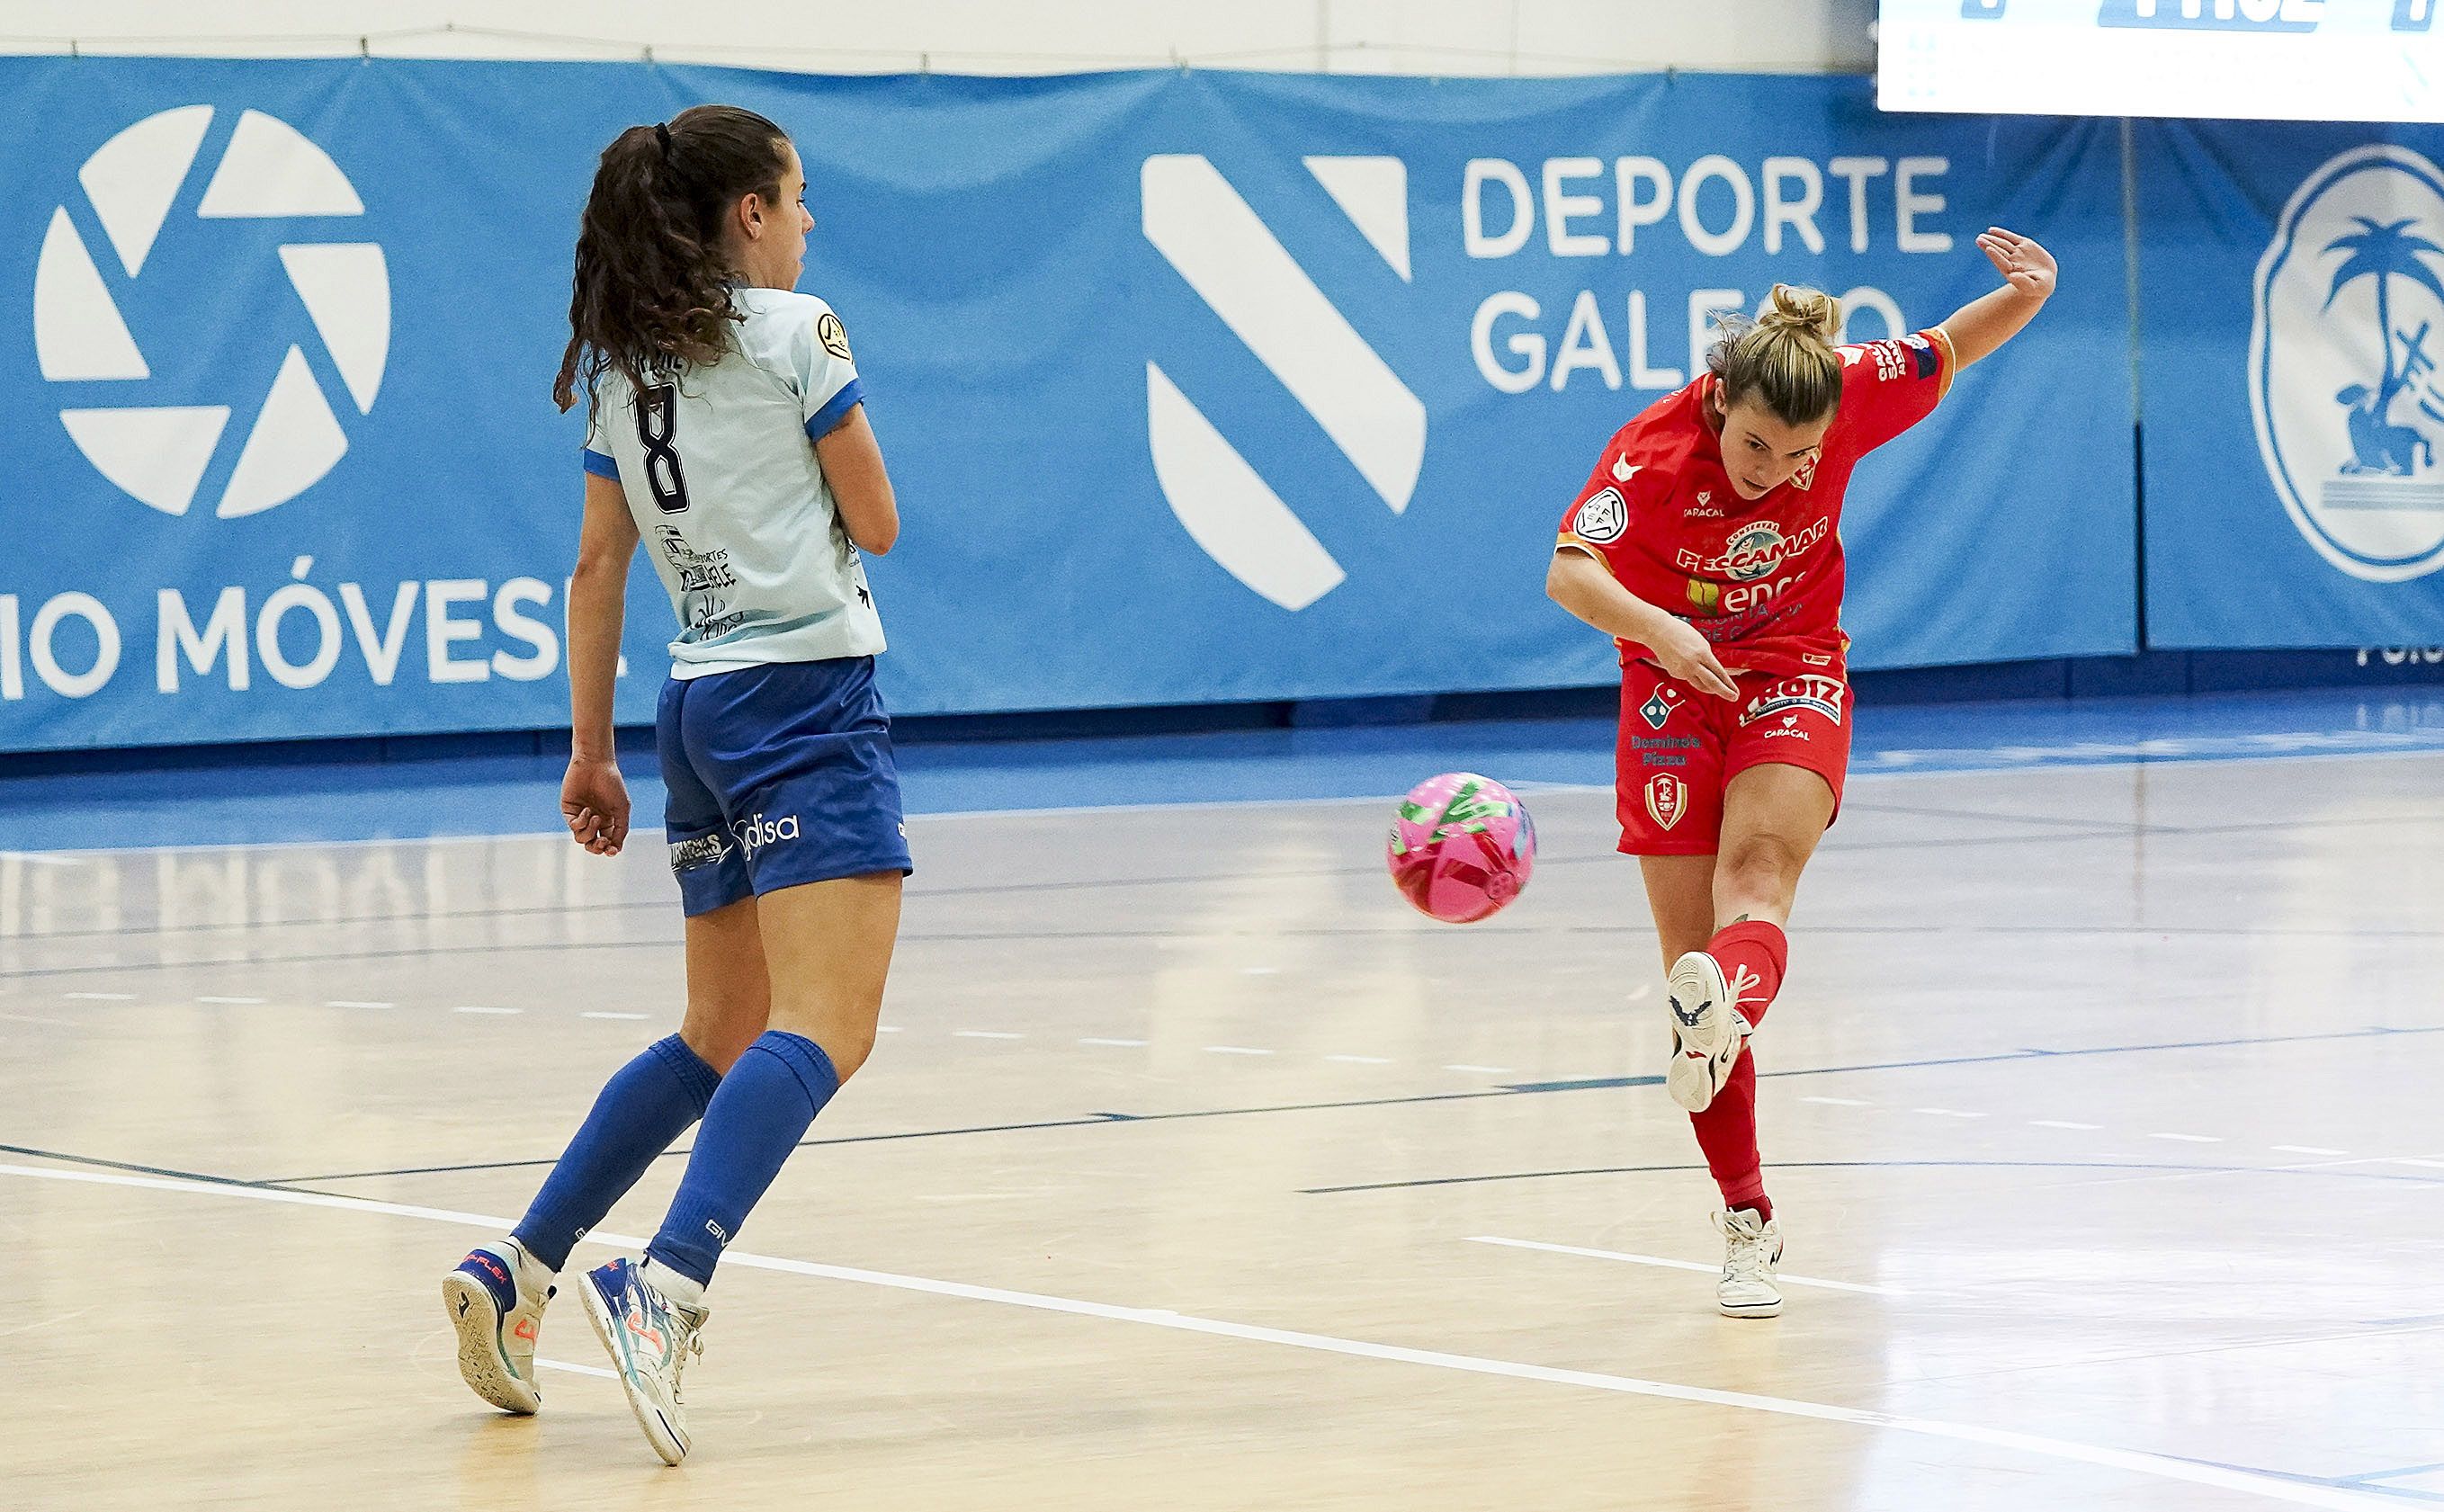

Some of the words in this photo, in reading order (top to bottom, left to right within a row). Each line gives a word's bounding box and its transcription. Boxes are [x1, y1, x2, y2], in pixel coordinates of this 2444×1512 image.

[1461, 156, 1953, 258] DEPORTE
[1471, 286, 1906, 393] GALEO
[633, 381, 690, 514] 8
[1632, 735, 1701, 748] Domino's
[1764, 729, 1810, 741] CARACAL
